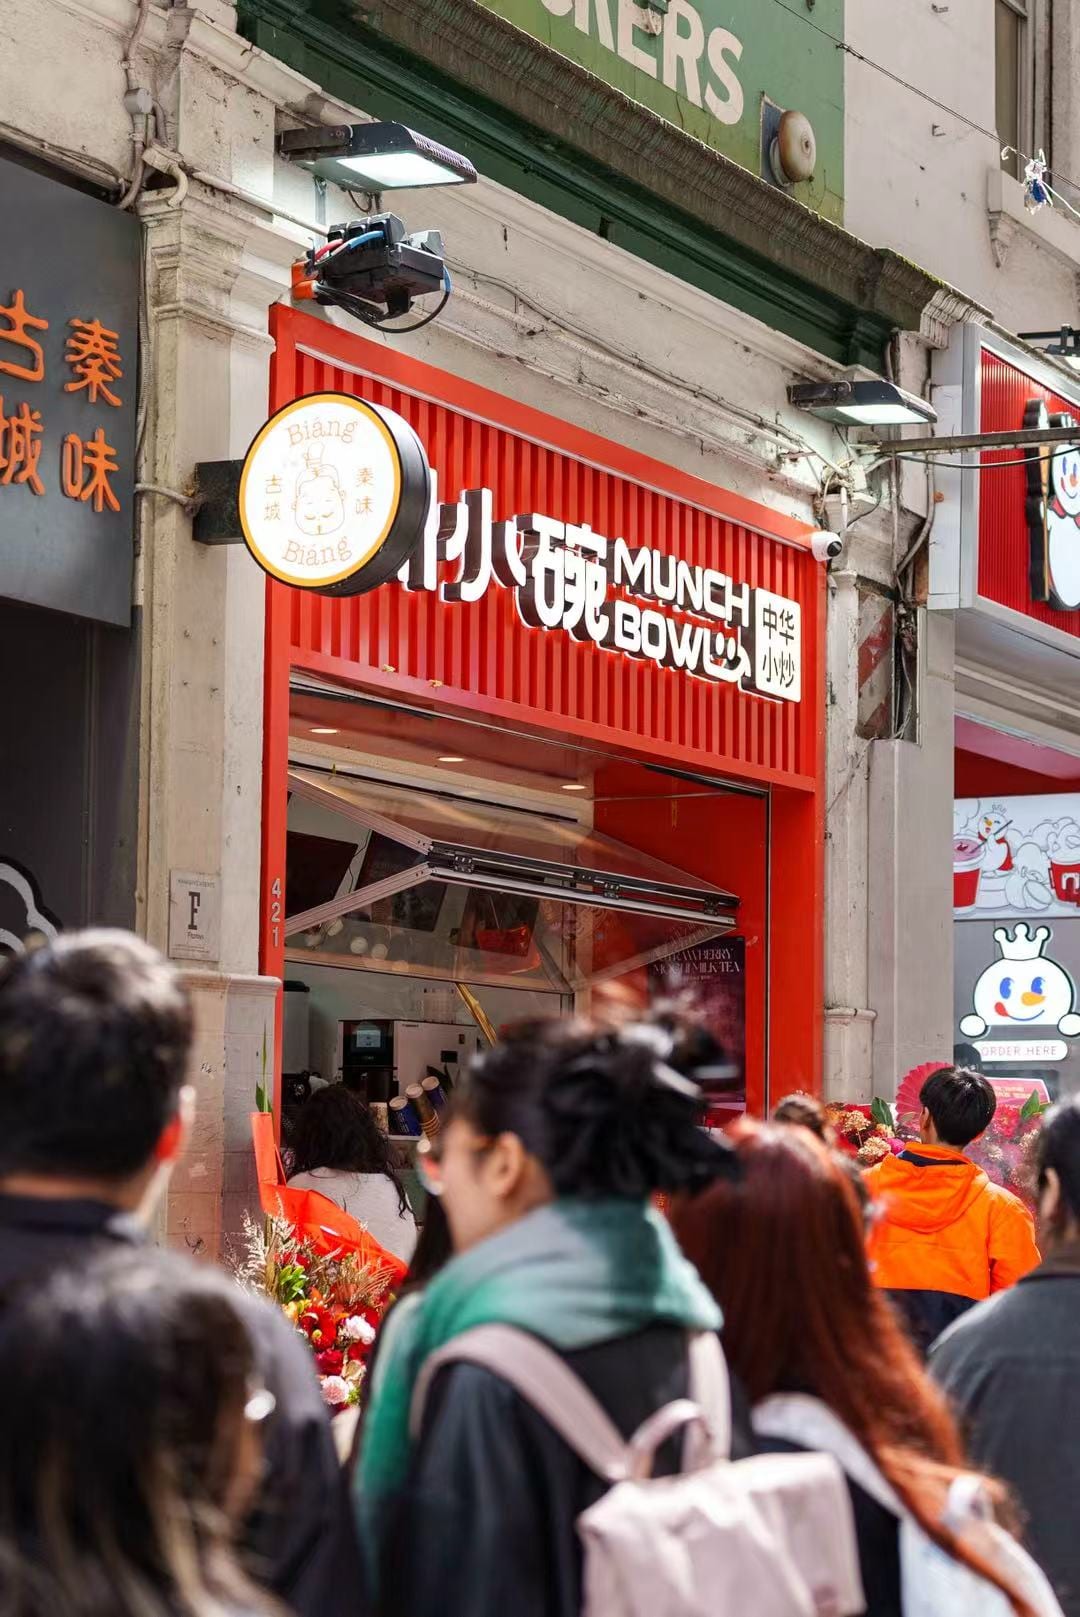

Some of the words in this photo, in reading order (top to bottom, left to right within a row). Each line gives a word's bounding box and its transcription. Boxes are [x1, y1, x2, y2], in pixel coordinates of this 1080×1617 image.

[541, 0, 744, 125] ERS
[64, 317, 122, 513] 秦味
[398, 468, 609, 642] 小碗
[614, 537, 749, 627] MUNCH
[614, 599, 748, 683] BOWL
[762, 602, 795, 646] 中华
[762, 646, 795, 688] 小炒
[271, 877, 282, 947] 421
[719, 961, 741, 974] TEA
[981, 1046, 1020, 1057] ORDER
[1027, 1045, 1057, 1056] HERE
